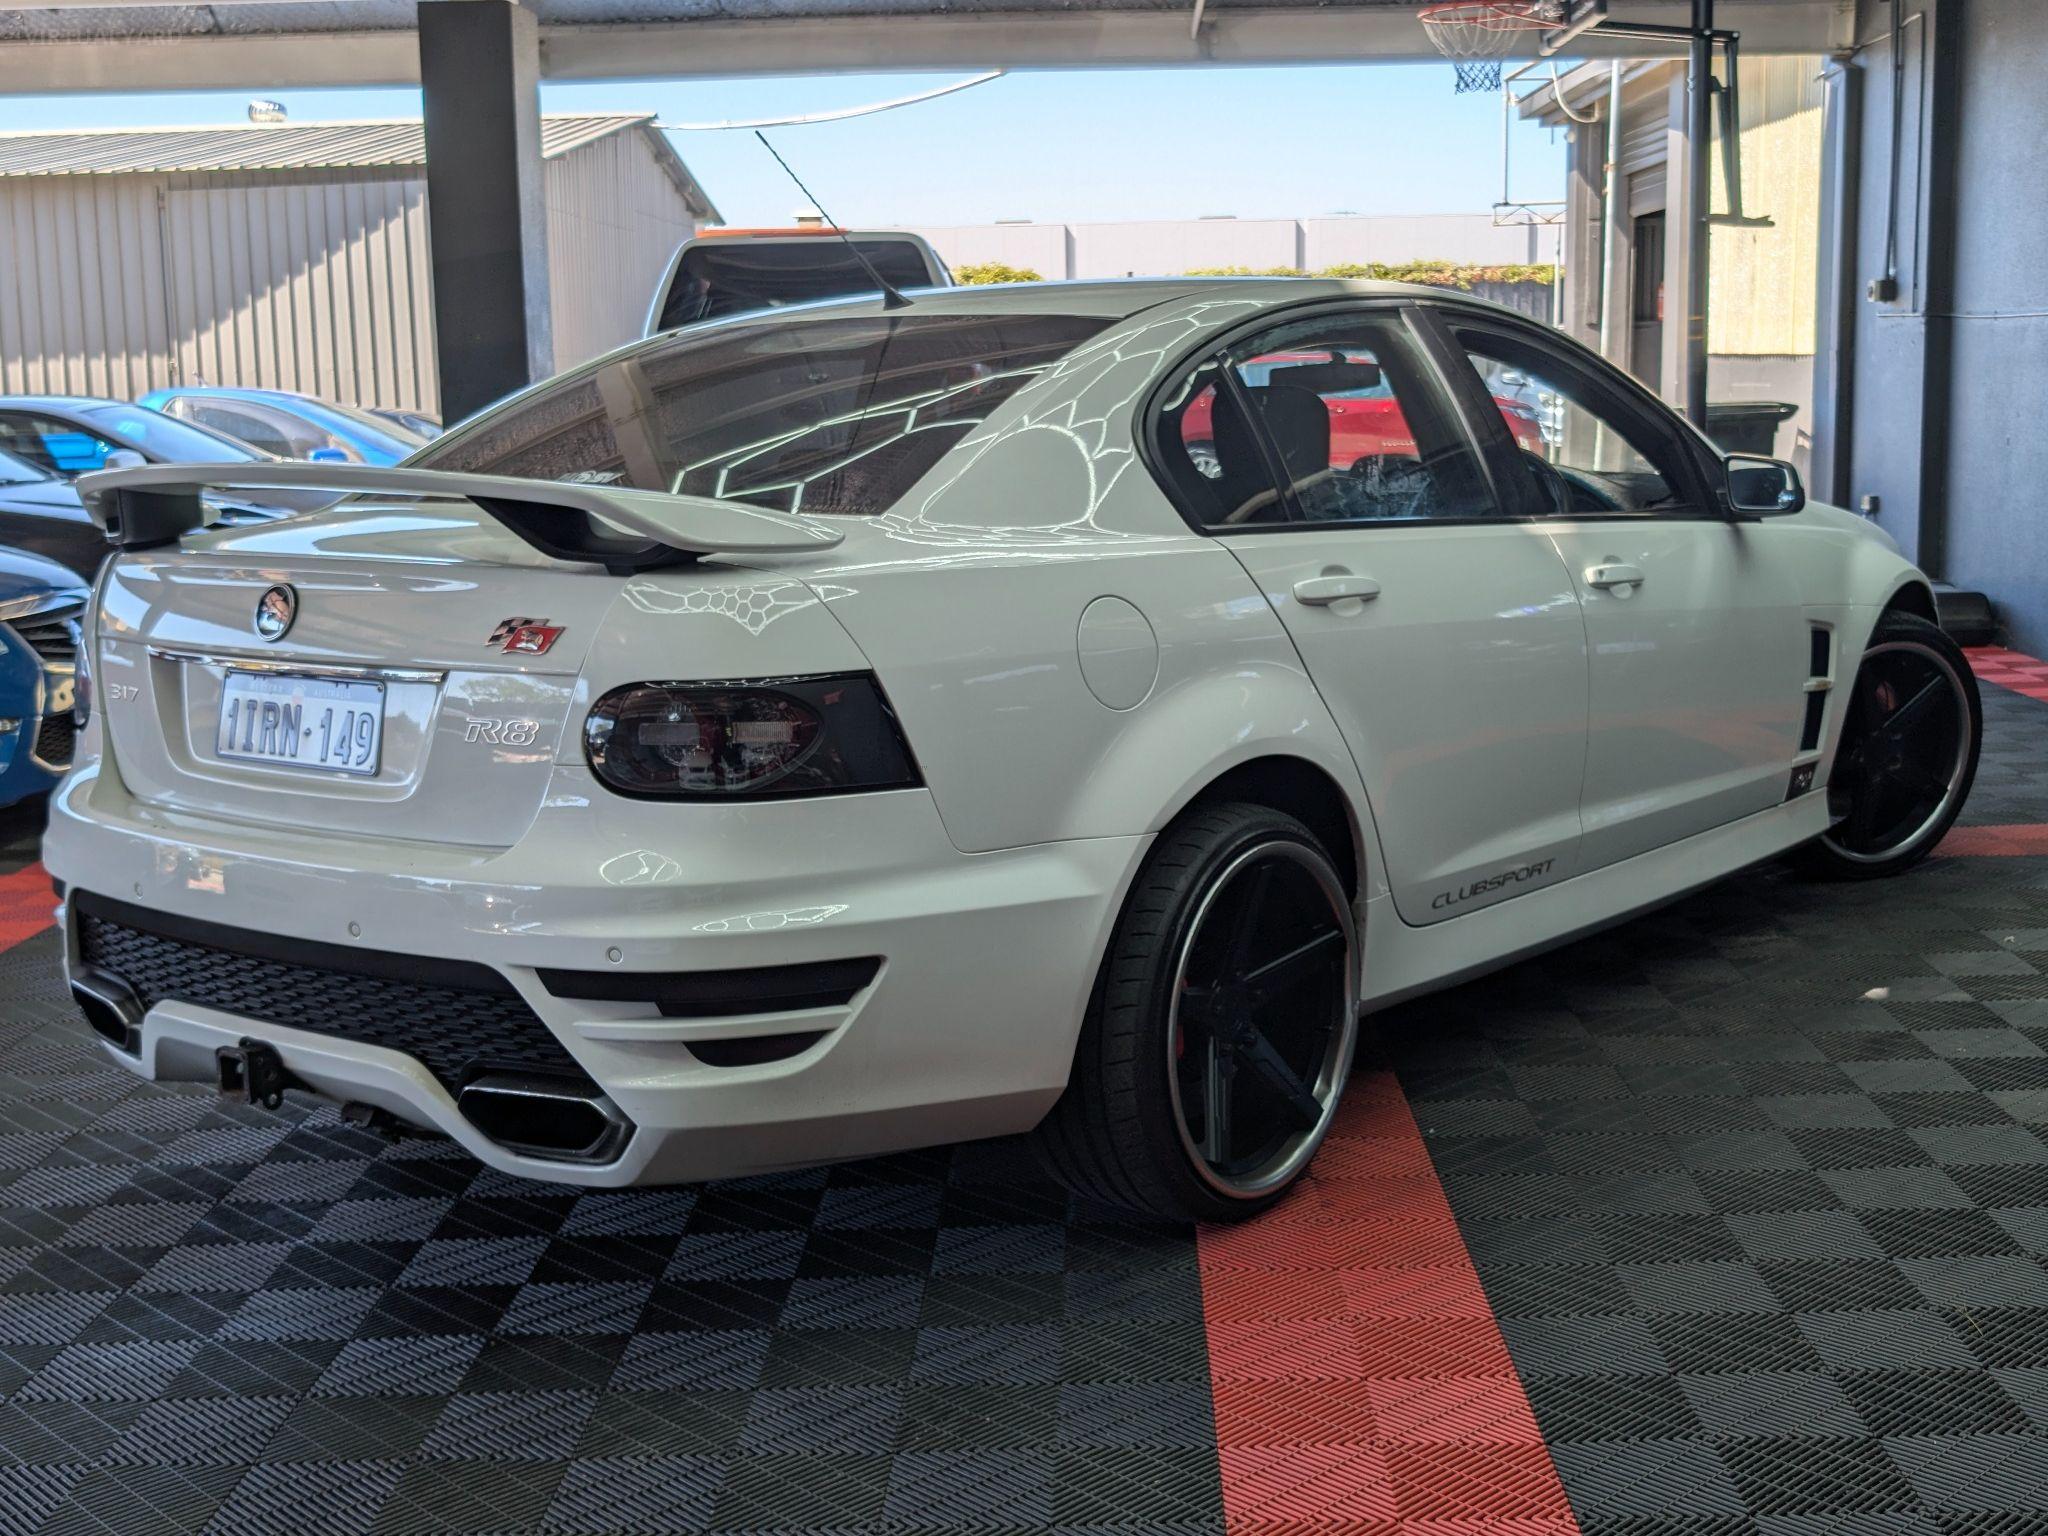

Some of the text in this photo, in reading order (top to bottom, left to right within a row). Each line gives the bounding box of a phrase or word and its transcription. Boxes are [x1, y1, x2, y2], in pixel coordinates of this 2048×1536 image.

[111, 683, 139, 701] 317
[465, 717, 539, 746] R8
[1431, 857, 1556, 910] CLUBSPORT
